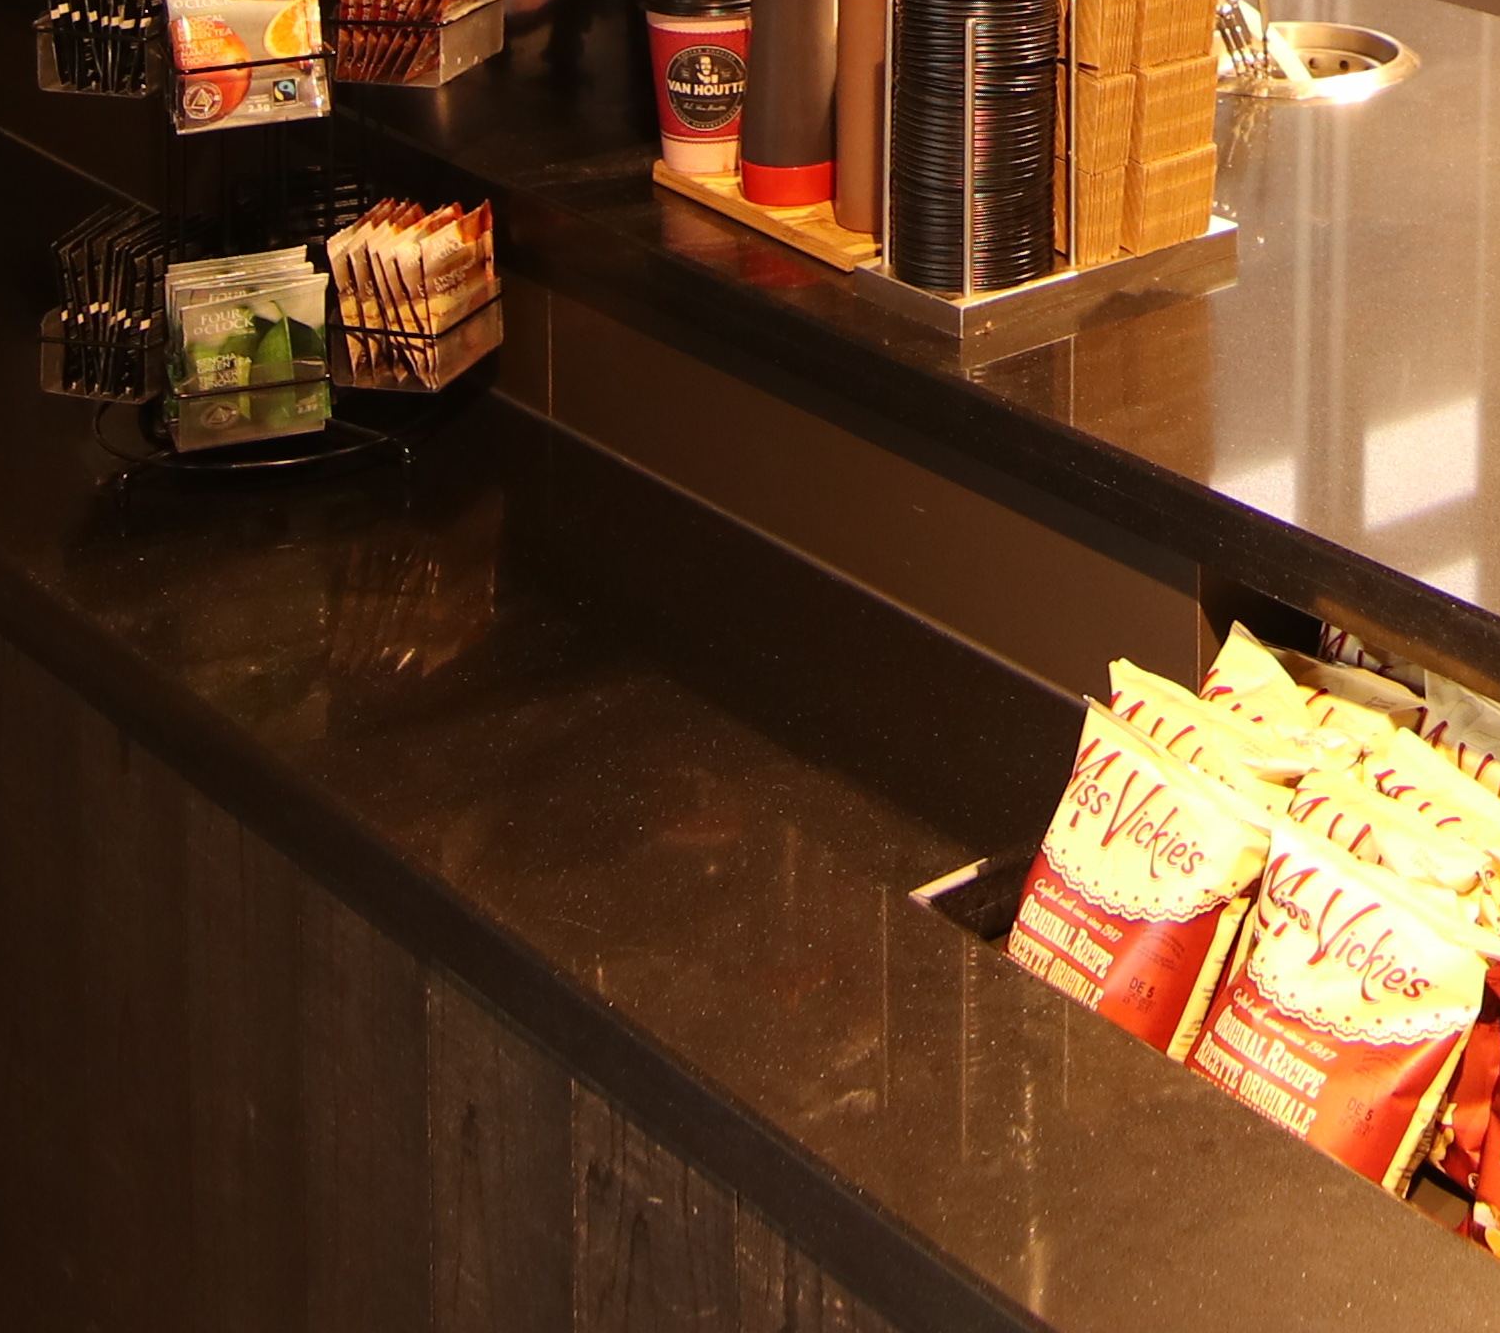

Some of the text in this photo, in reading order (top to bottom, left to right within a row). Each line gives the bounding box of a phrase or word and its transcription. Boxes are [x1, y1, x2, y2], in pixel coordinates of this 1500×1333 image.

[667, 79, 691, 95] VAN
[201, 308, 241, 326] FOUR
[1100, 770, 1204, 879] Vickie's
[1019, 894, 1073, 957] ORIGINAL
[1069, 924, 1114, 979] RECIPE
[1308, 888, 1430, 1003] Vickie's
[1194, 1031, 1317, 1136] RECETTE ORIGINALE
[1215, 1005, 1327, 1099] ORIGINAL RECIPE
